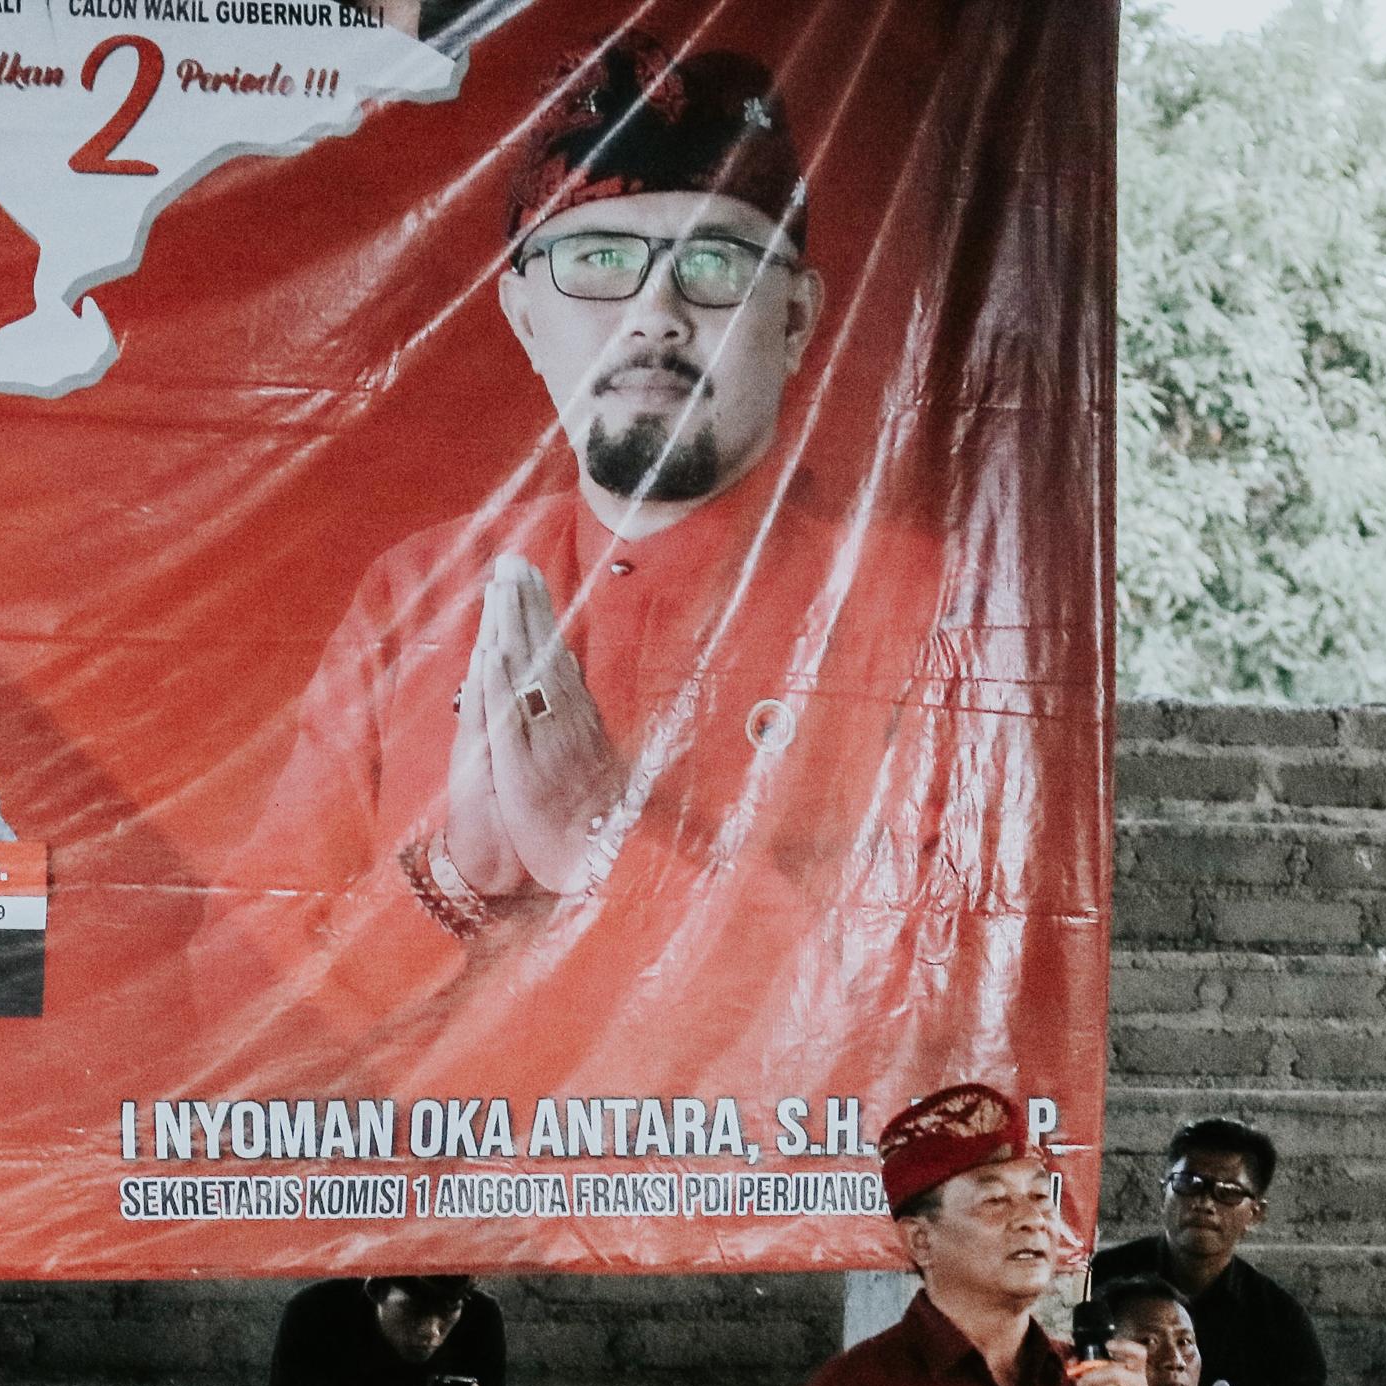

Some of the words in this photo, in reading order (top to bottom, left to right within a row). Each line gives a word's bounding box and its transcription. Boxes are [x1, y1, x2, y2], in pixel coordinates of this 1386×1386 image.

[69, 0, 137, 18] CALON
[144, 0, 209, 22] WAKIL
[216, 1, 332, 27] GUBERNUR
[339, 5, 384, 28] BALI
[68, 33, 164, 176] 2
[176, 58, 296, 97] Periode
[305, 67, 340, 98] !!!
[120, 1100, 137, 1160] I
[154, 1098, 395, 1160] NYOMAN
[410, 1097, 514, 1159] OKA
[528, 1096, 760, 1165] ANTARA,
[120, 1175, 303, 1220] SEKRETARIS
[306, 1174, 408, 1219] KOMISI
[413, 1174, 432, 1219] 1
[434, 1173, 570, 1219] ANGGOTA
[574, 1171, 678, 1217] FRAKSI
[682, 1171, 732, 1217] PDI
[735, 1171, 891, 1217] PERJUANGA
